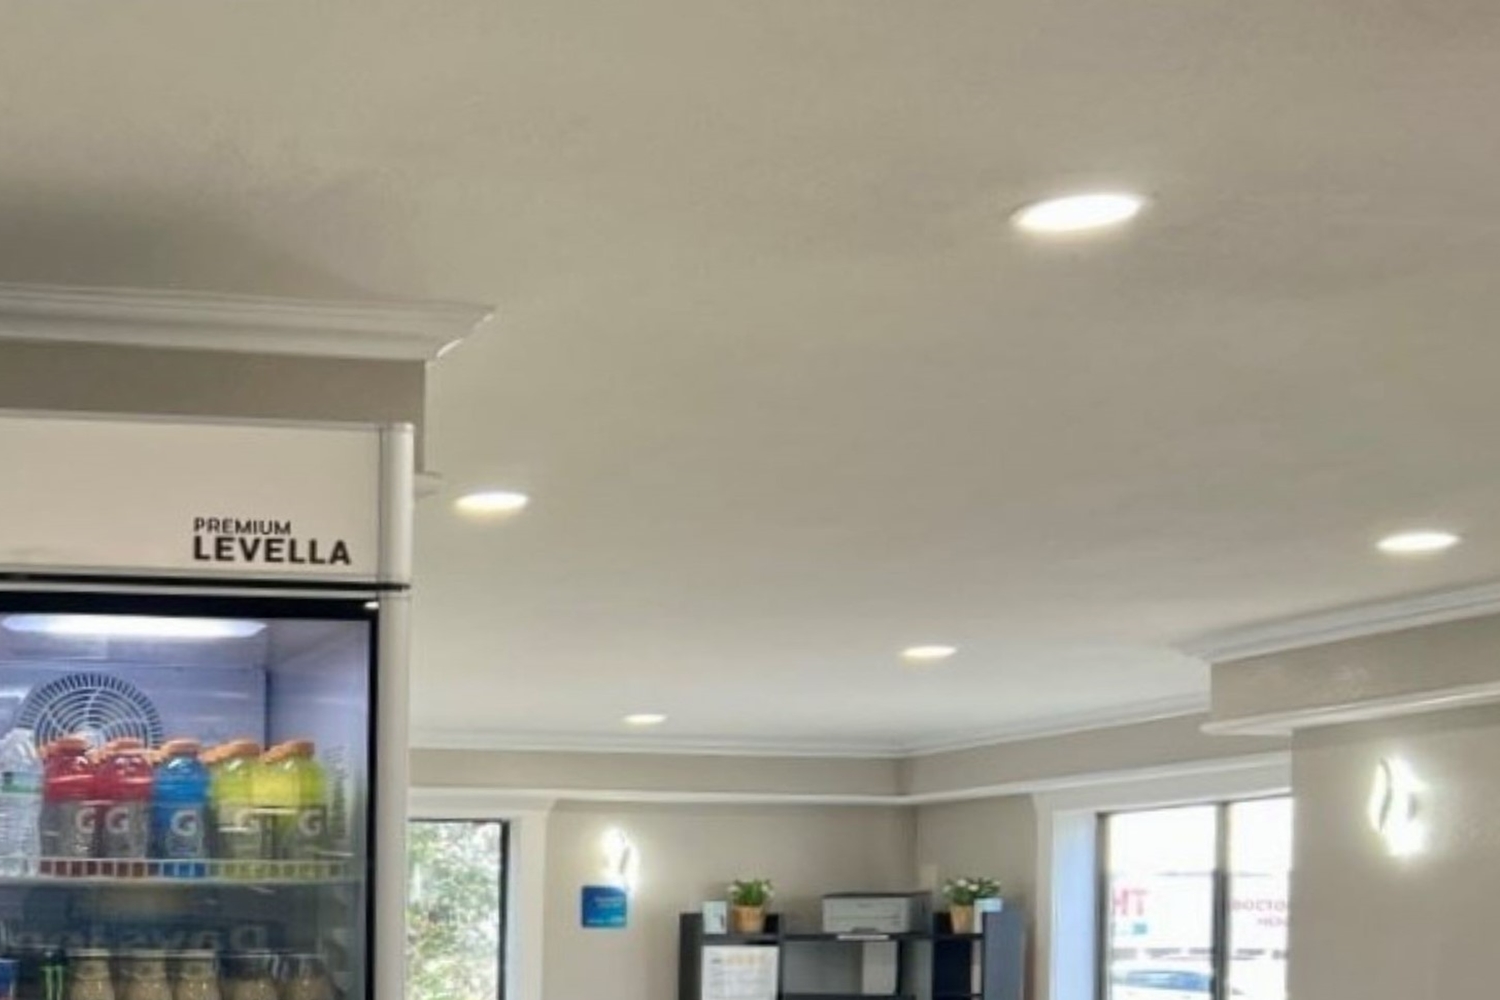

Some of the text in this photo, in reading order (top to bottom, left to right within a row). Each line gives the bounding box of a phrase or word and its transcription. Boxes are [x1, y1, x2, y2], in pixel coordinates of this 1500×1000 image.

[192, 517, 292, 536] PREMIUM
[192, 536, 353, 566] LEVELLA
[104, 806, 131, 834] G
[172, 810, 199, 837] G
